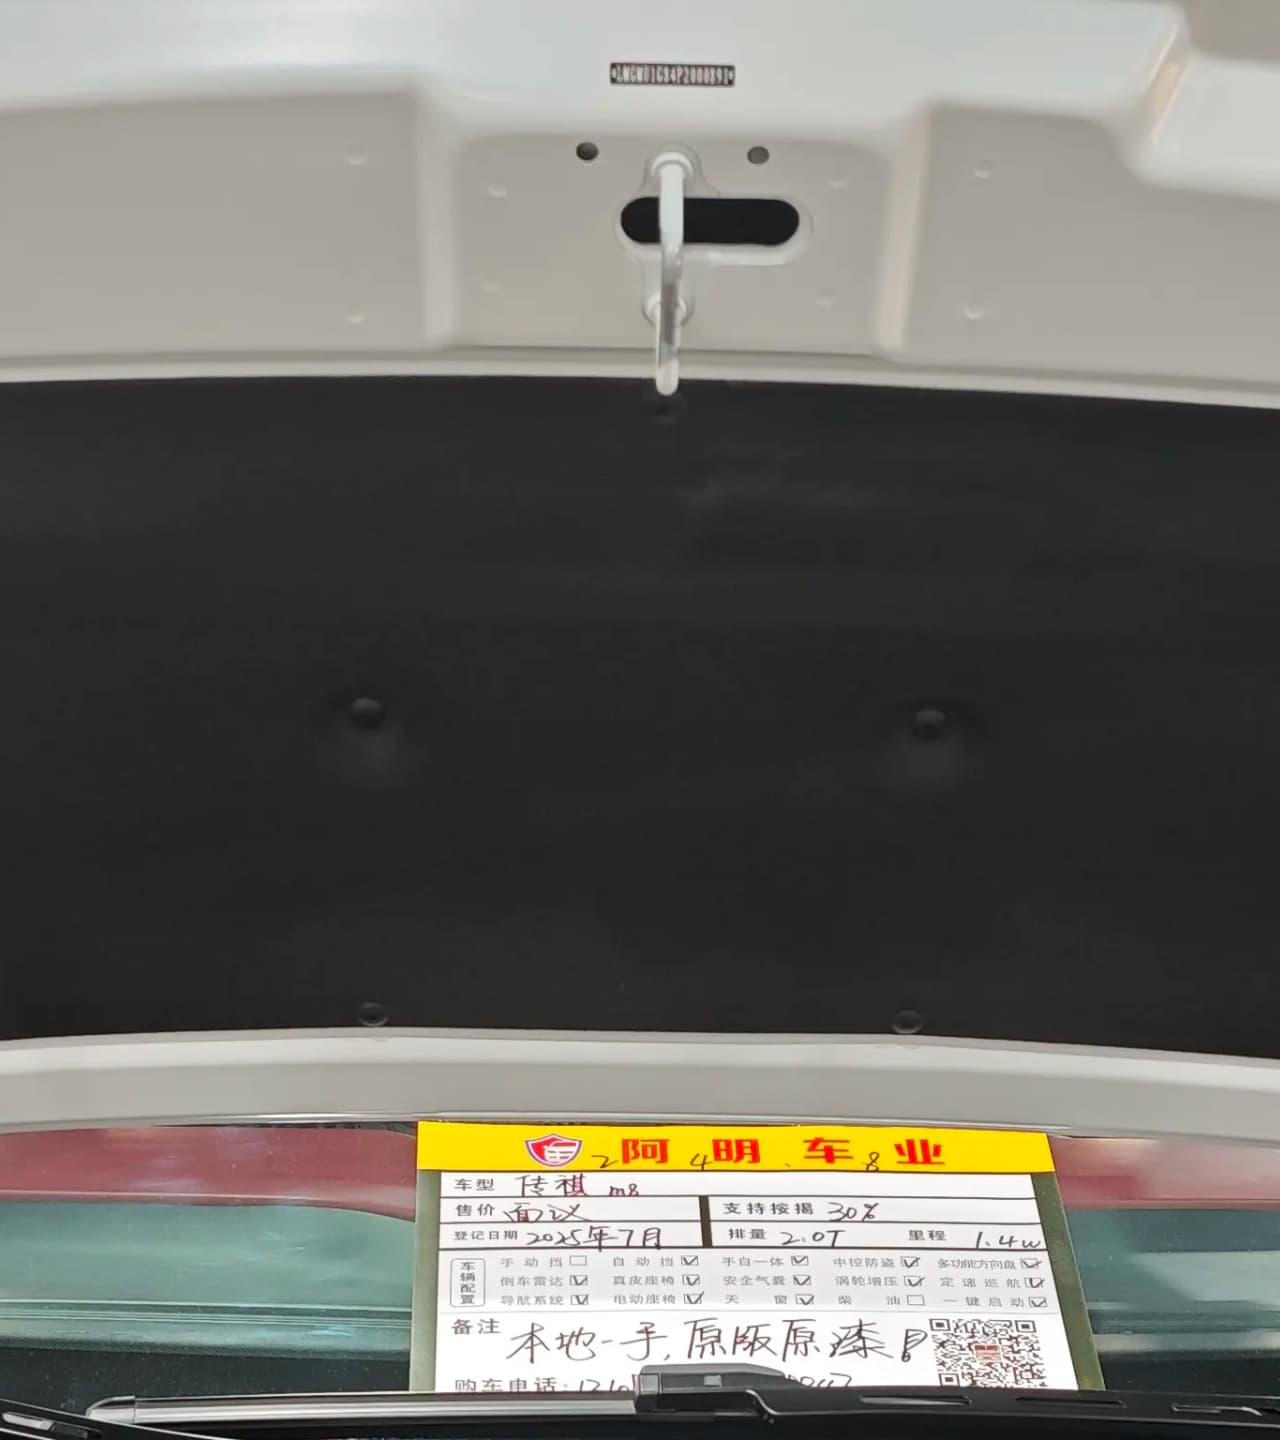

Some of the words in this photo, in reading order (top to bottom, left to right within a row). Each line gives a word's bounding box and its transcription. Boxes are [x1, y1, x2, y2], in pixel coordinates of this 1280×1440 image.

[622, 1137, 945, 1165] 阿明车业
[454, 1177, 495, 1191] 车型
[455, 1203, 495, 1216] 售价
[723, 1202, 814, 1216] 支持按揭
[827, 1202, 879, 1222] 30%
[454, 1229, 518, 1241] 登记日期
[526, 1225, 662, 1252] 2025年7月
[728, 1228, 767, 1240] 排量
[781, 1229, 846, 1247] 2.0T
[908, 1229, 947, 1242] 里程
[500, 1256, 563, 1268] 手动挡
[613, 1256, 674, 1268] 自动挡
[721, 1256, 784, 1268] 手自一体
[833, 1257, 895, 1269] 中控防盗
[938, 1258, 1017, 1270] 多功能方向盘
[460, 1261, 477, 1305] 车辆配置
[500, 1275, 564, 1287] 倒车雷达
[613, 1275, 675, 1287] 真皮座椅
[723, 1275, 786, 1287] 安全气囊
[835, 1276, 898, 1288] 涡轮增压
[940, 1277, 1020, 1289] 定速巡航
[500, 1294, 564, 1306] 导航系统
[613, 1294, 676, 1306] 电动座椅
[725, 1294, 787, 1306] 天窗
[837, 1295, 900, 1307] 柴油
[943, 1295, 1024, 1308] 一键启动
[451, 1318, 500, 1335] 备注
